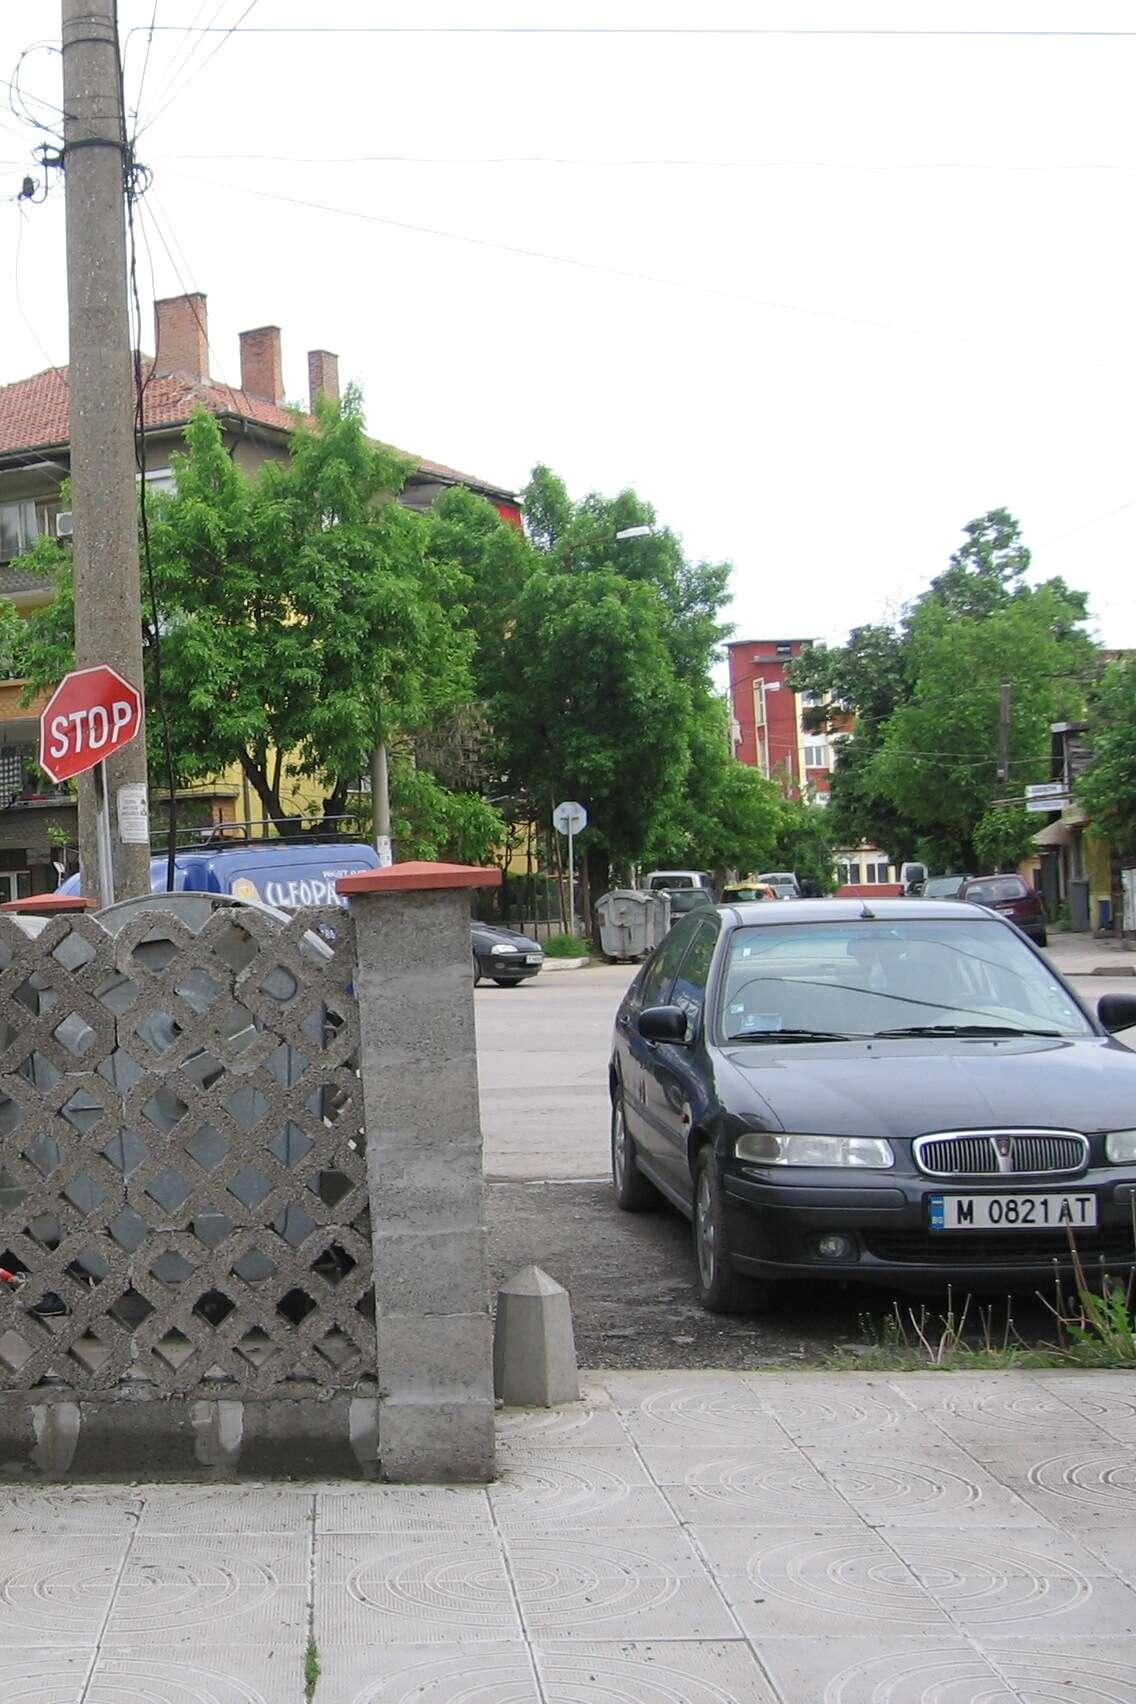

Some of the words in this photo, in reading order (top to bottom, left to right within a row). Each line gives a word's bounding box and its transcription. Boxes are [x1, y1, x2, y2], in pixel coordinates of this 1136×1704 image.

[50, 701, 132, 758] STOP
[266, 880, 348, 907] CLEOPA
[988, 1199, 1048, 1224] 0821
